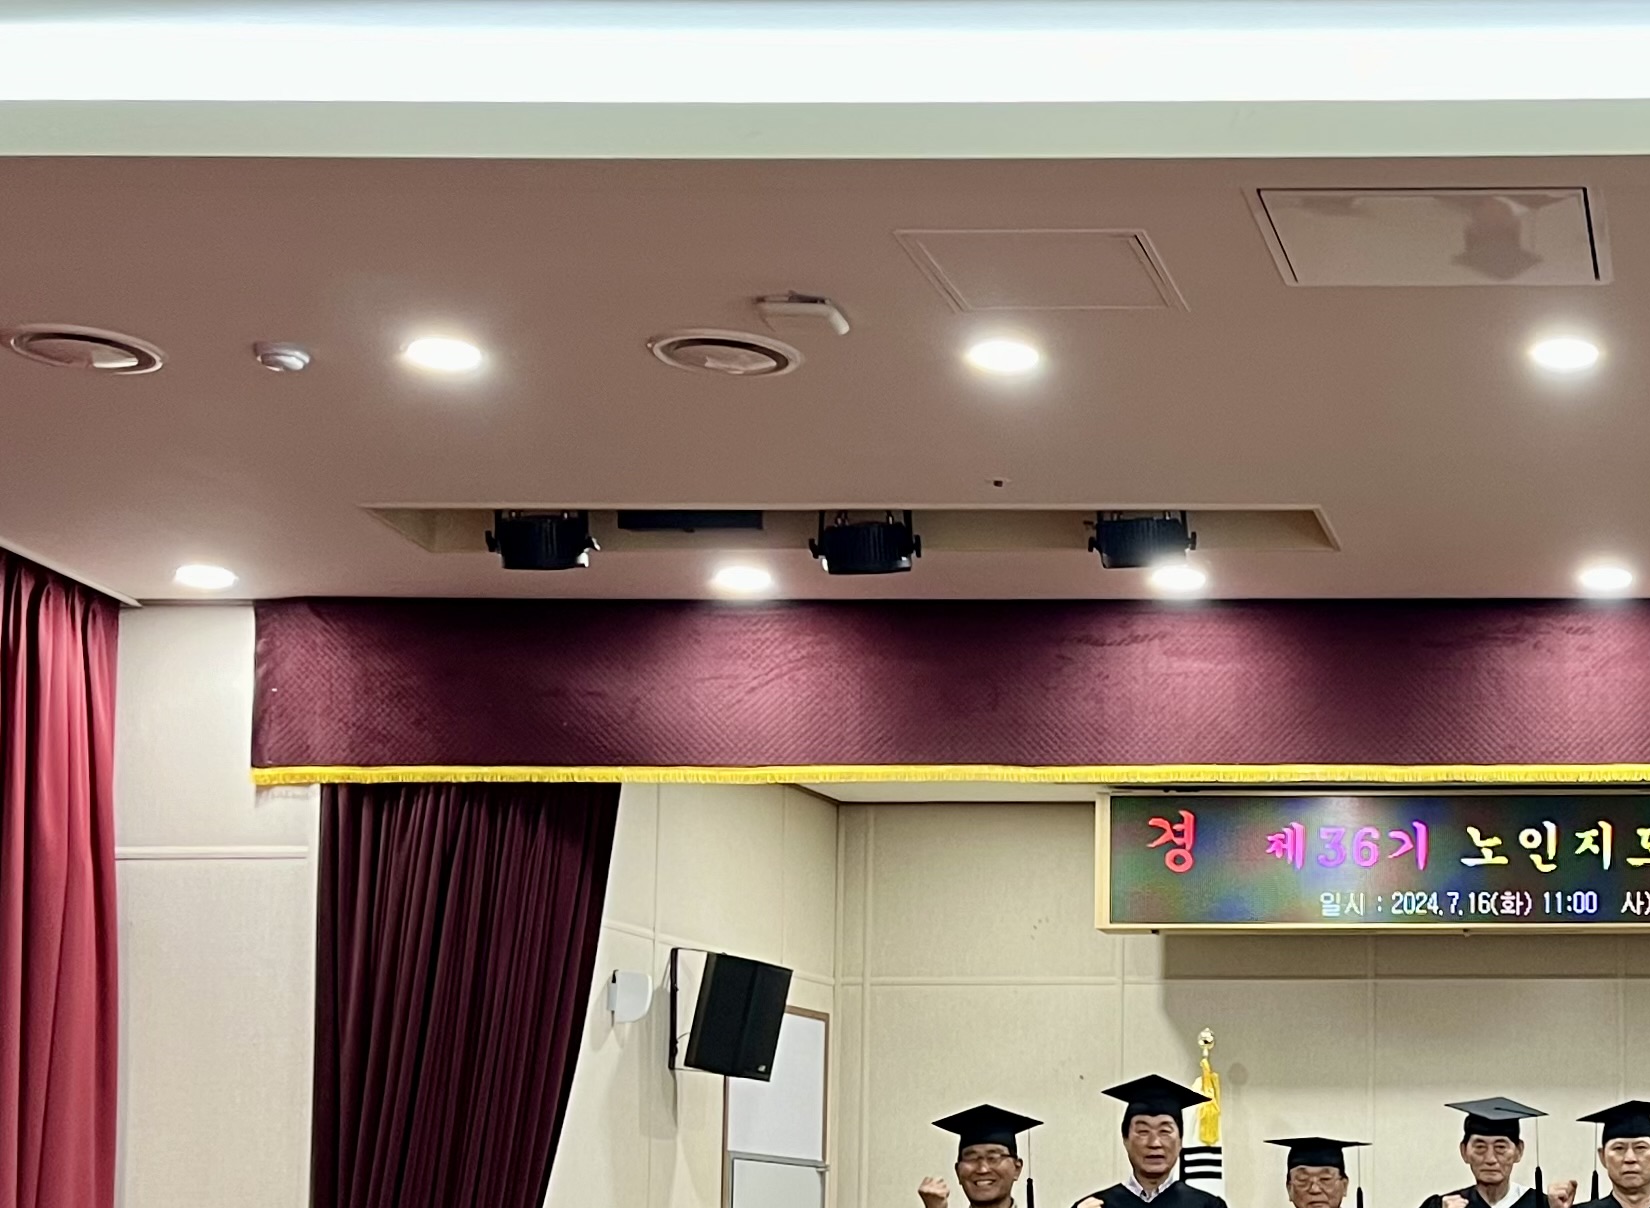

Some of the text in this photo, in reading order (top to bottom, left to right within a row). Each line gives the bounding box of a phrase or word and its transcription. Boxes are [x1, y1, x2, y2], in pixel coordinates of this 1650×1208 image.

[1146, 809, 1197, 873] 경
[1265, 820, 1430, 871] 제36기
[1319, 890, 1366, 917] 일시
[1543, 890, 1598, 915] 11:00
